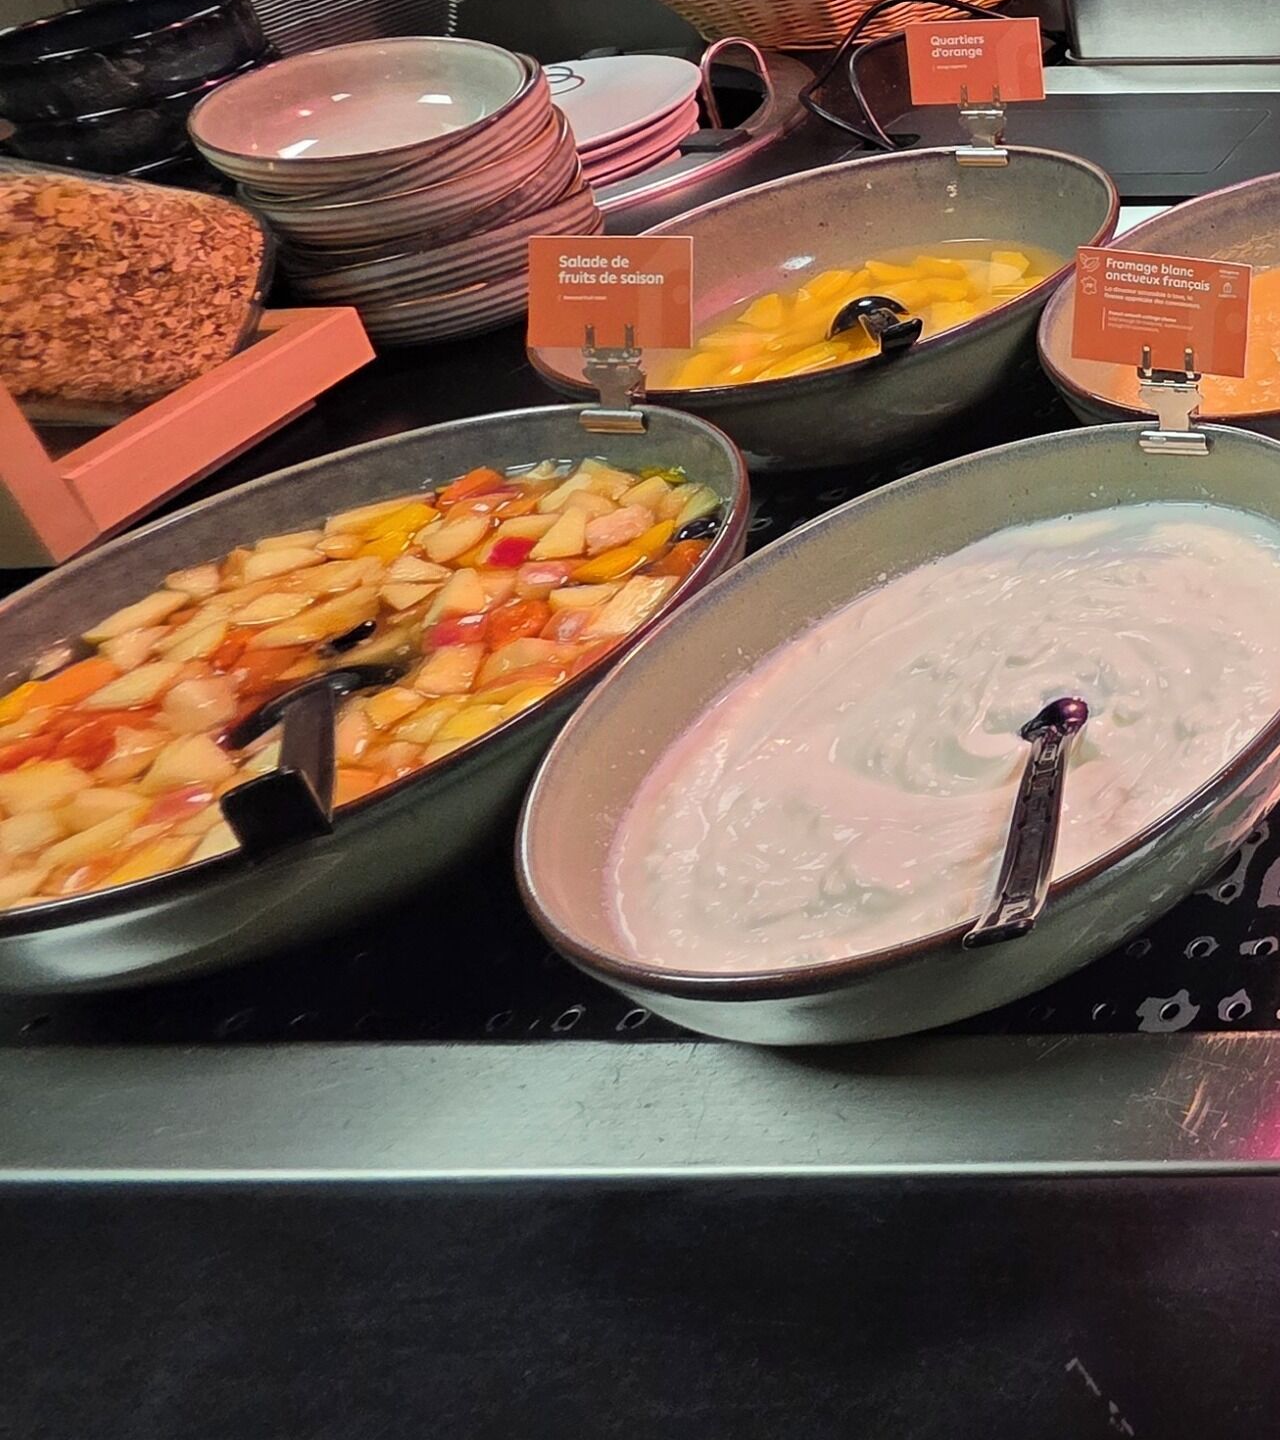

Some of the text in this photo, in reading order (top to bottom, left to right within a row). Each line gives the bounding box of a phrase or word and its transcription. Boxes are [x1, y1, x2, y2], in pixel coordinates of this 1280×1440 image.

[930, 35, 984, 46] Quartiers
[931, 48, 983, 59] d'orange
[558, 255, 630, 268] Salade de
[1105, 258, 1194, 278] Fromage blanc
[558, 271, 664, 285] fruits de saison
[1105, 272, 1161, 286] onctueux
[1162, 275, 1211, 292] français
